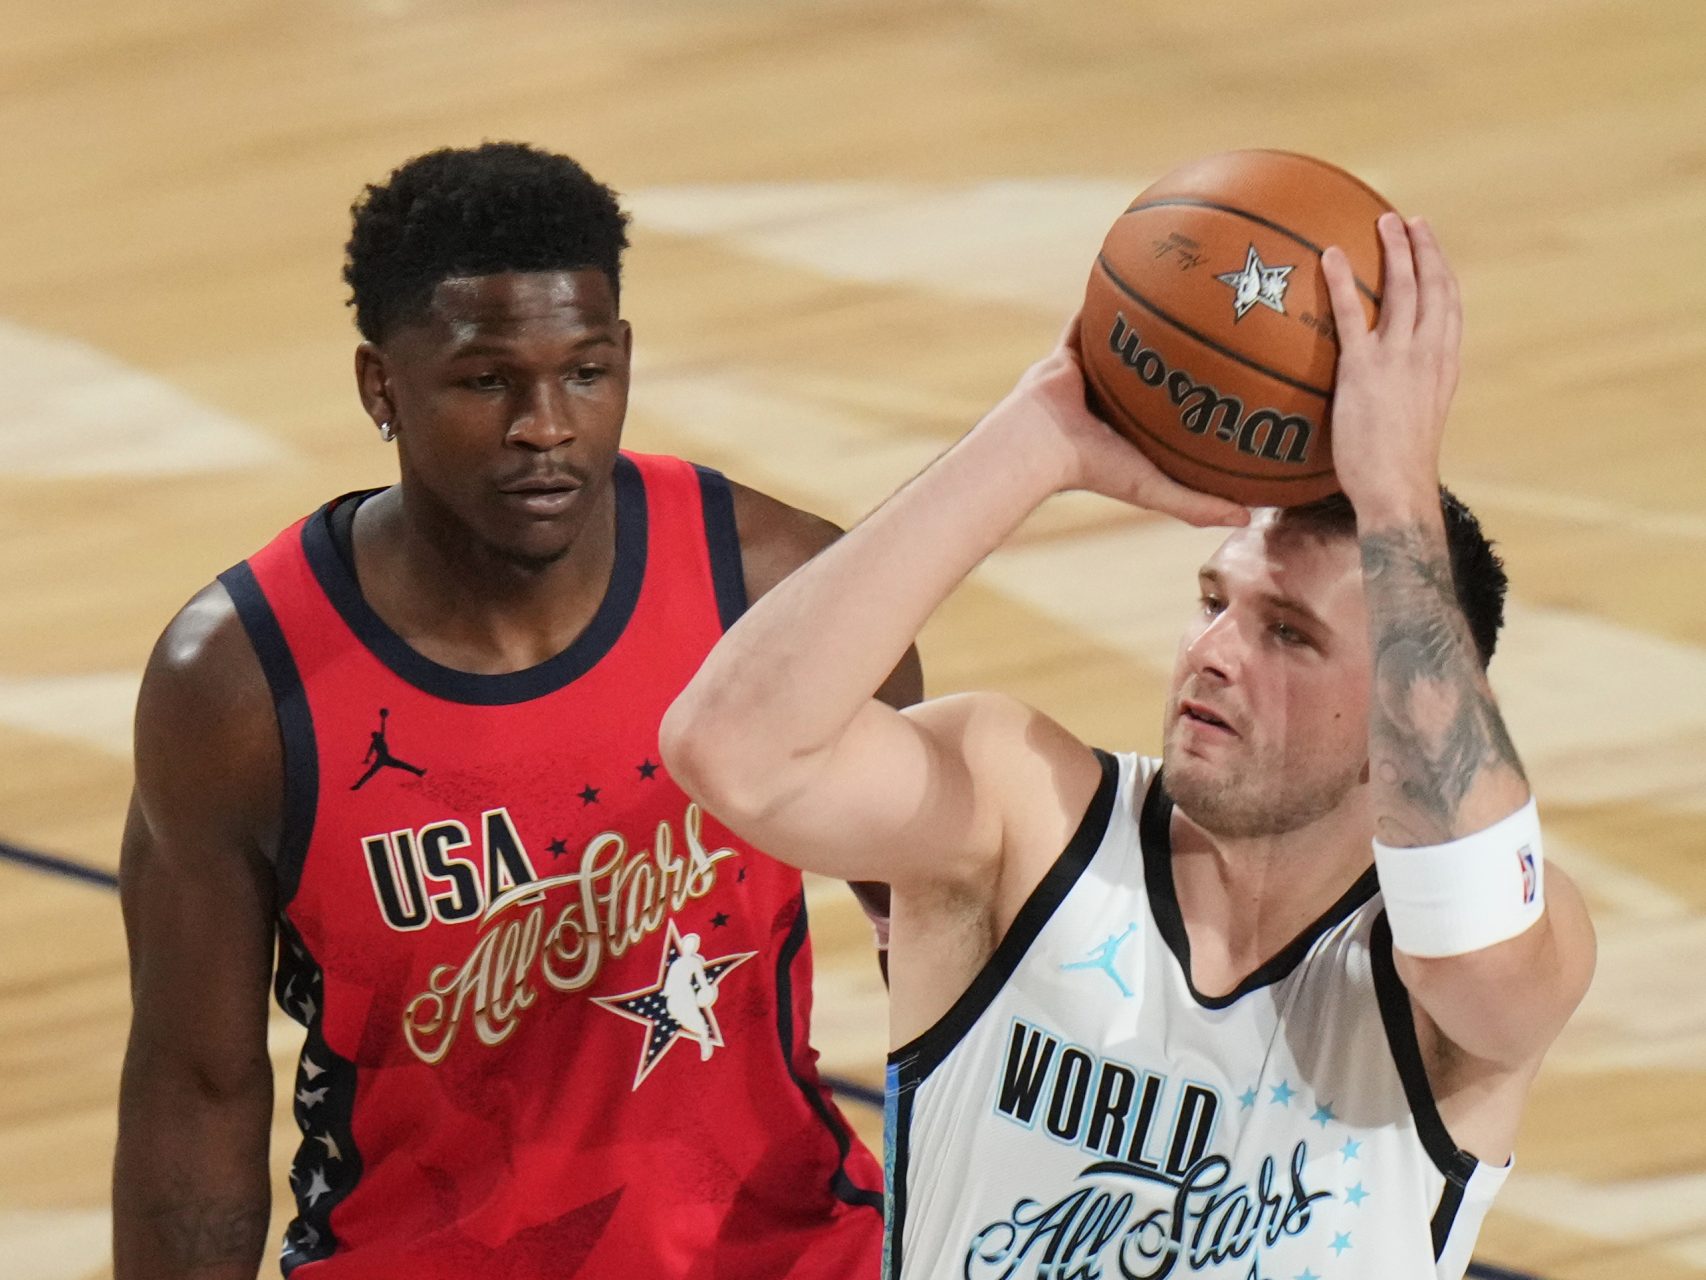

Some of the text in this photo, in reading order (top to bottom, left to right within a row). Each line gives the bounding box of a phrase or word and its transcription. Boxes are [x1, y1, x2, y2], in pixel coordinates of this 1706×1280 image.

[1109, 311, 1312, 463] Wilson
[361, 807, 546, 932] USA
[404, 803, 739, 1065] All Stars
[994, 1016, 1222, 1178] WORLD
